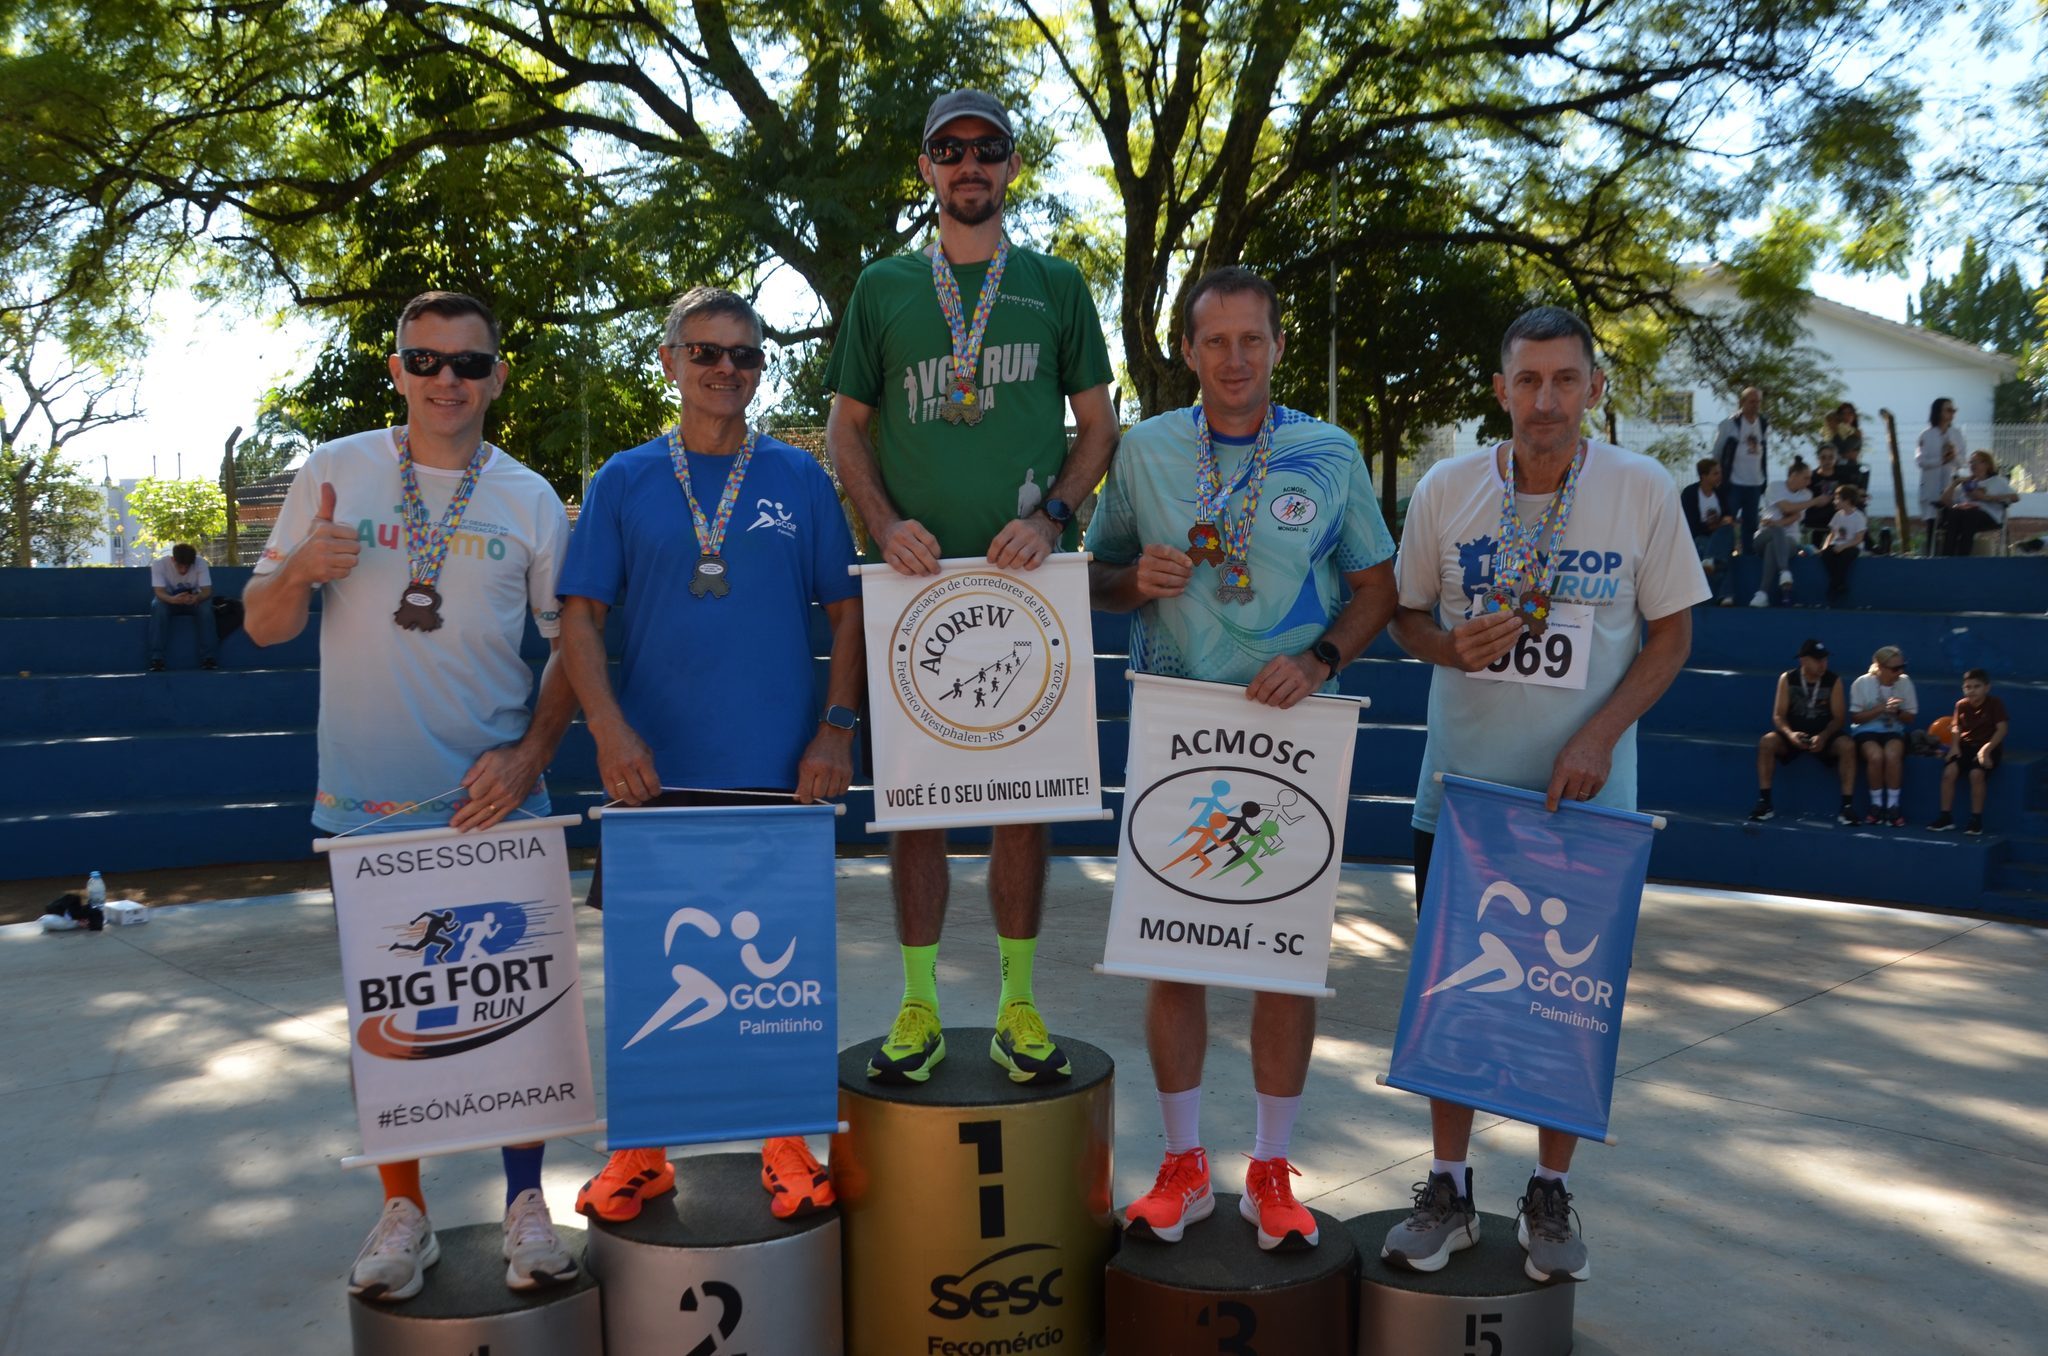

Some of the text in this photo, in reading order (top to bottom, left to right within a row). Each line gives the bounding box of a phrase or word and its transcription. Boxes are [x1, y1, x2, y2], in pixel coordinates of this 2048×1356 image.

[983, 343, 1040, 387] RUN
[1283, 486, 1307, 494] ACMOSC
[775, 518, 797, 532] GCOR
[901, 577, 1051, 636] Associação de Corredores de Rua
[1558, 575, 1620, 599] RUN
[919, 604, 1015, 676] ACORFW
[896, 661, 921, 712] Frederico
[1030, 661, 1065, 723] Desde 2024
[1170, 728, 1316, 774] ACMOSC
[886, 777, 1090, 808] VOCÊ É O SEU ÚNICO LIMITE!
[356, 837, 546, 879] ASSESSORIA
[1139, 917, 1254, 950] MONDAÍ
[1272, 932, 1305, 956] SC
[360, 955, 554, 1013] BIG FORT
[729, 981, 822, 1011] GCOR
[1526, 966, 1613, 1008] GCOR
[473, 996, 526, 1022] RUN
[739, 1018, 823, 1036] Palmitinho
[1529, 1001, 1609, 1034] Palmitinho
[377, 1083, 576, 1129] #ÉSÓNÃOPARAR
[958, 1120, 1006, 1240] 1
[680, 1281, 748, 1356] 2
[1196, 1300, 1258, 1356] 3
[1464, 1313, 1503, 1356] 5
[928, 1326, 1064, 1356] Fecomércio
